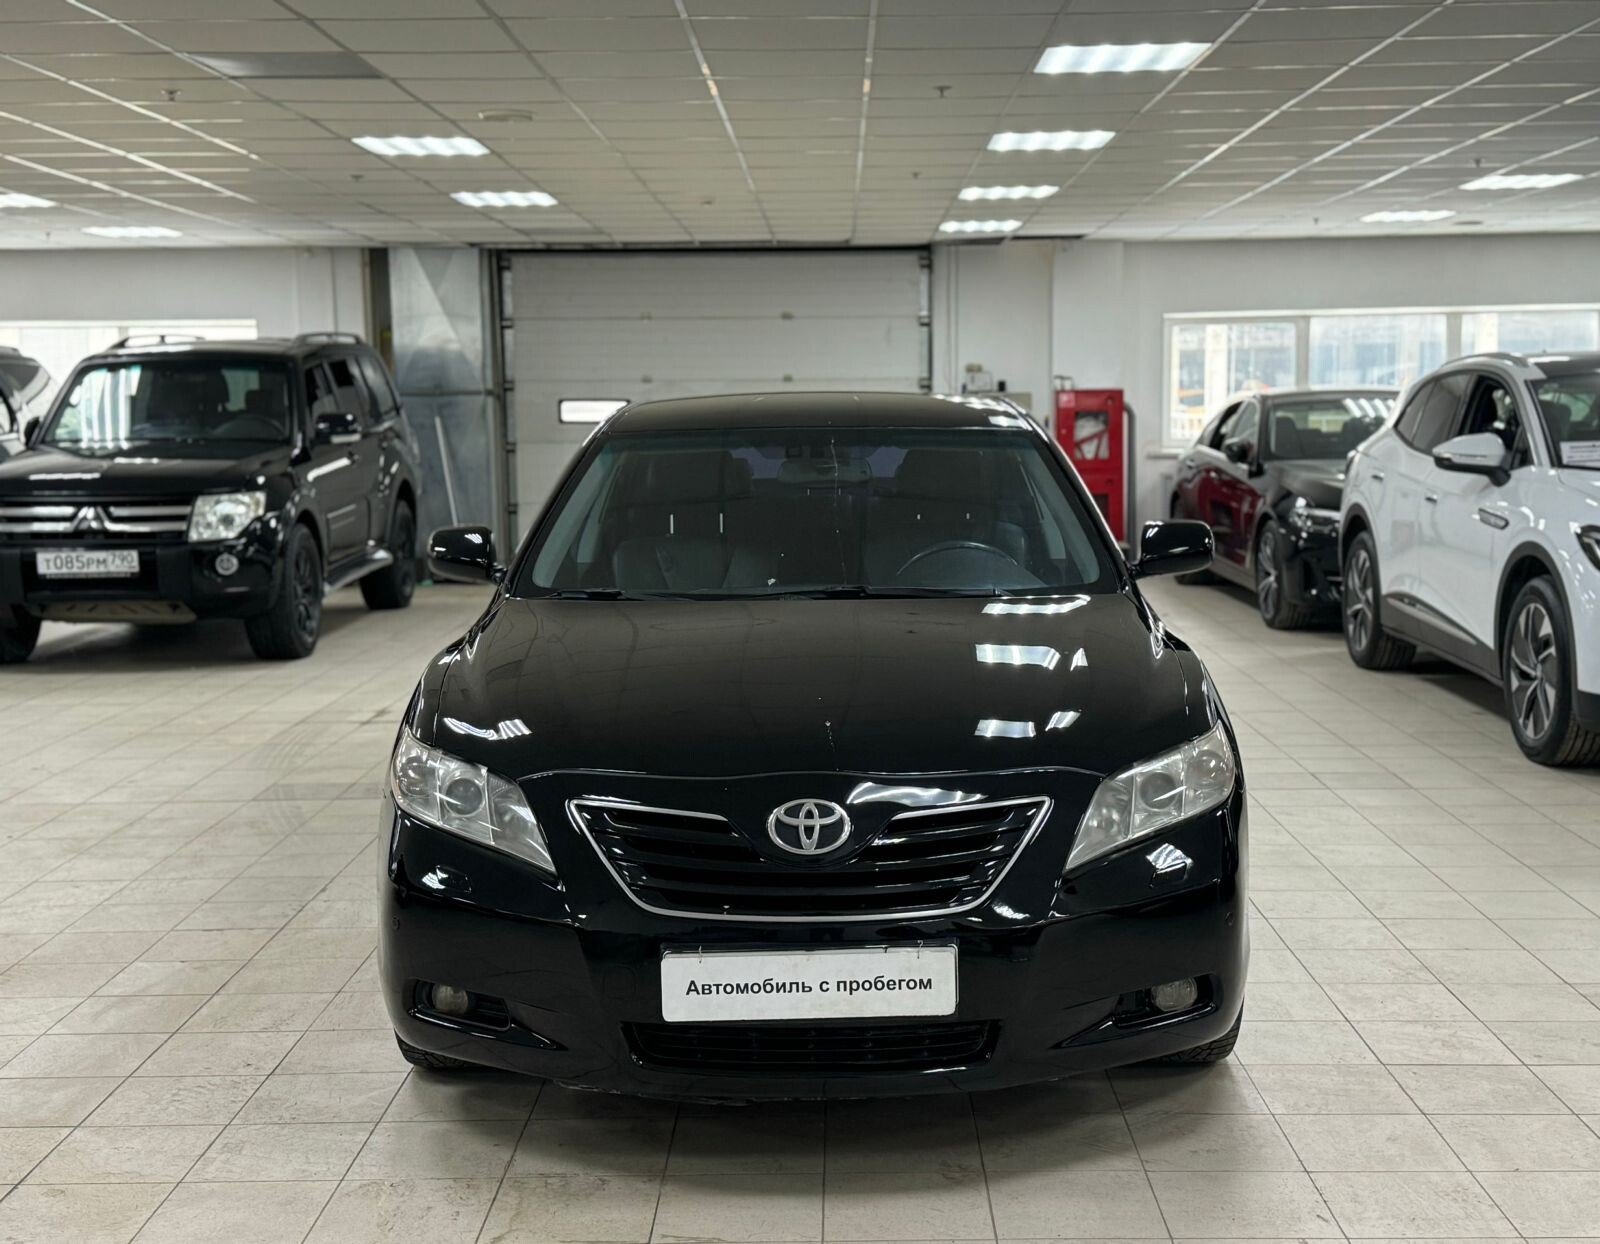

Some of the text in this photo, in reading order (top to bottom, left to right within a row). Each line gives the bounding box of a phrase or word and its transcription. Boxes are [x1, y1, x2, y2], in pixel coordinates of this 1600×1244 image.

[685, 975, 933, 996] Автомобиль с пробегом
